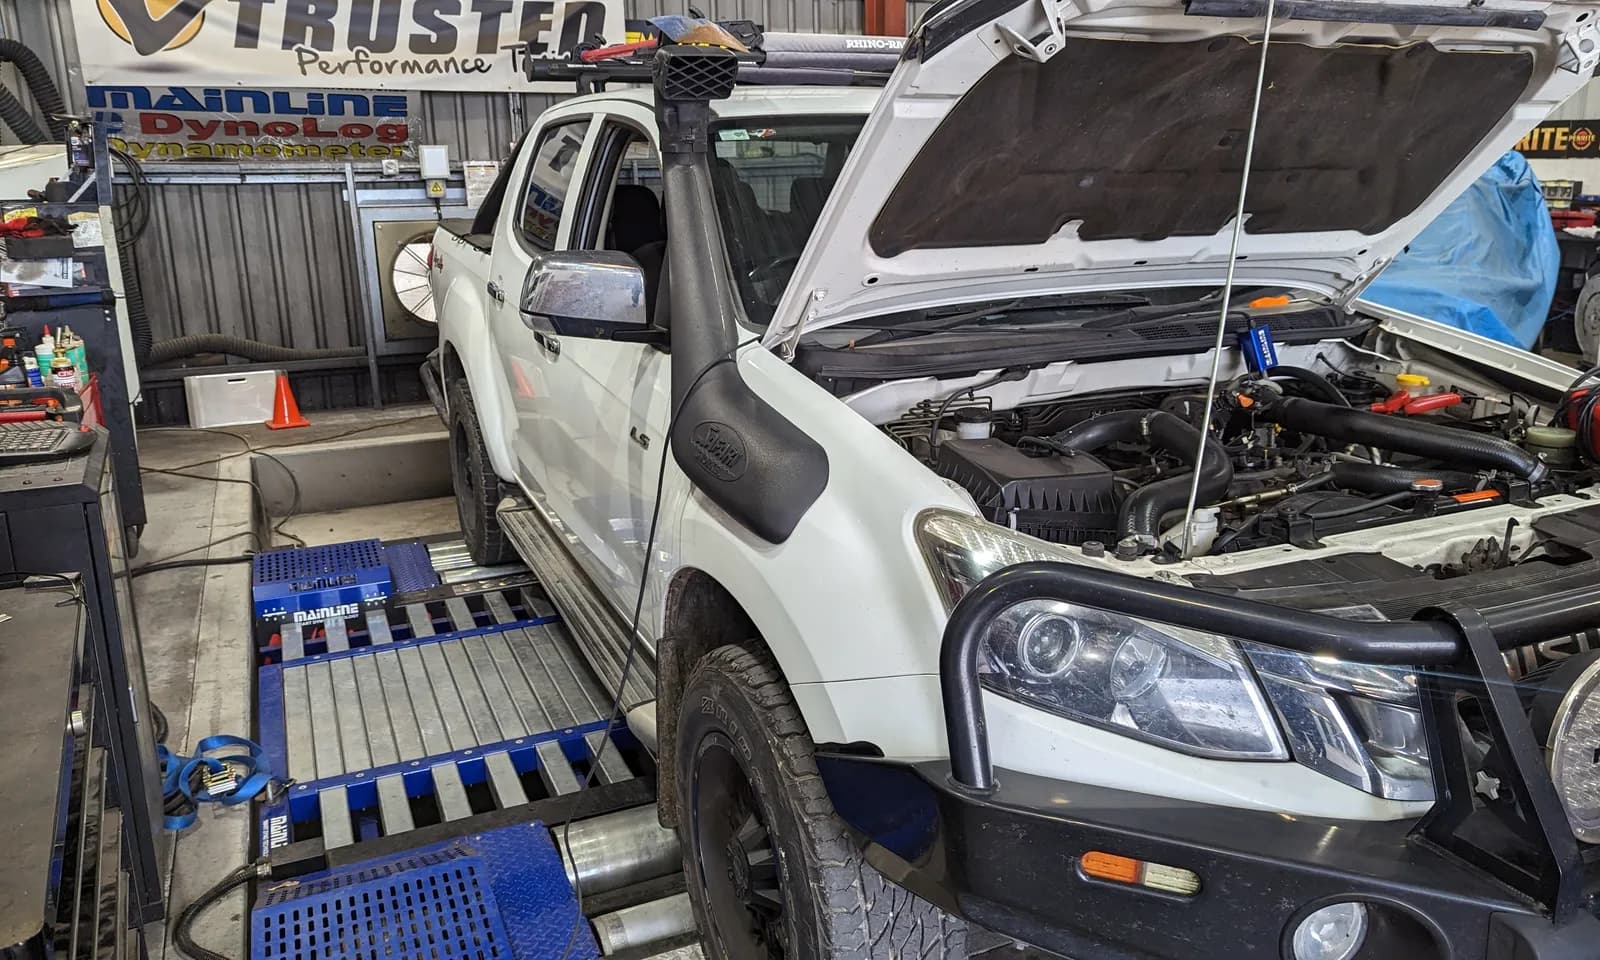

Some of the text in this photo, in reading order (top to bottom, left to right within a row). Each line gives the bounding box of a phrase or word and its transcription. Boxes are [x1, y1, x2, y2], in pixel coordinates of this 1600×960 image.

[297, 47, 492, 76] Performance
[139, 112, 409, 144] DynoLog
[630, 426, 650, 451] LS
